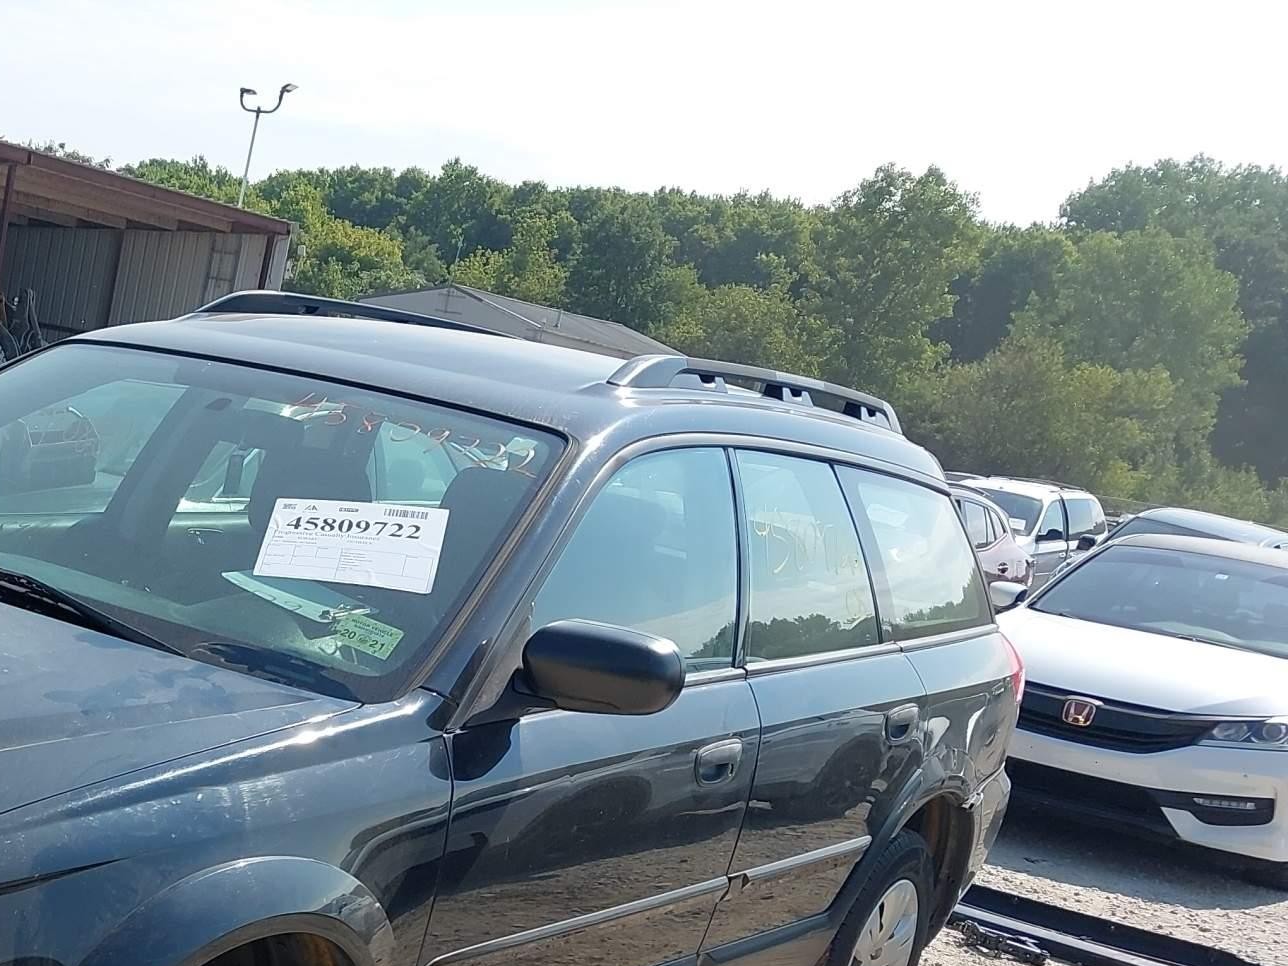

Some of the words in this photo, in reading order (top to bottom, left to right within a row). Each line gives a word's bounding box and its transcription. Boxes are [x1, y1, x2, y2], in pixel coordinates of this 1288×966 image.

[286, 516, 422, 540] 45809722
[340, 628, 357, 640] 20
[369, 640, 386, 651] 21
